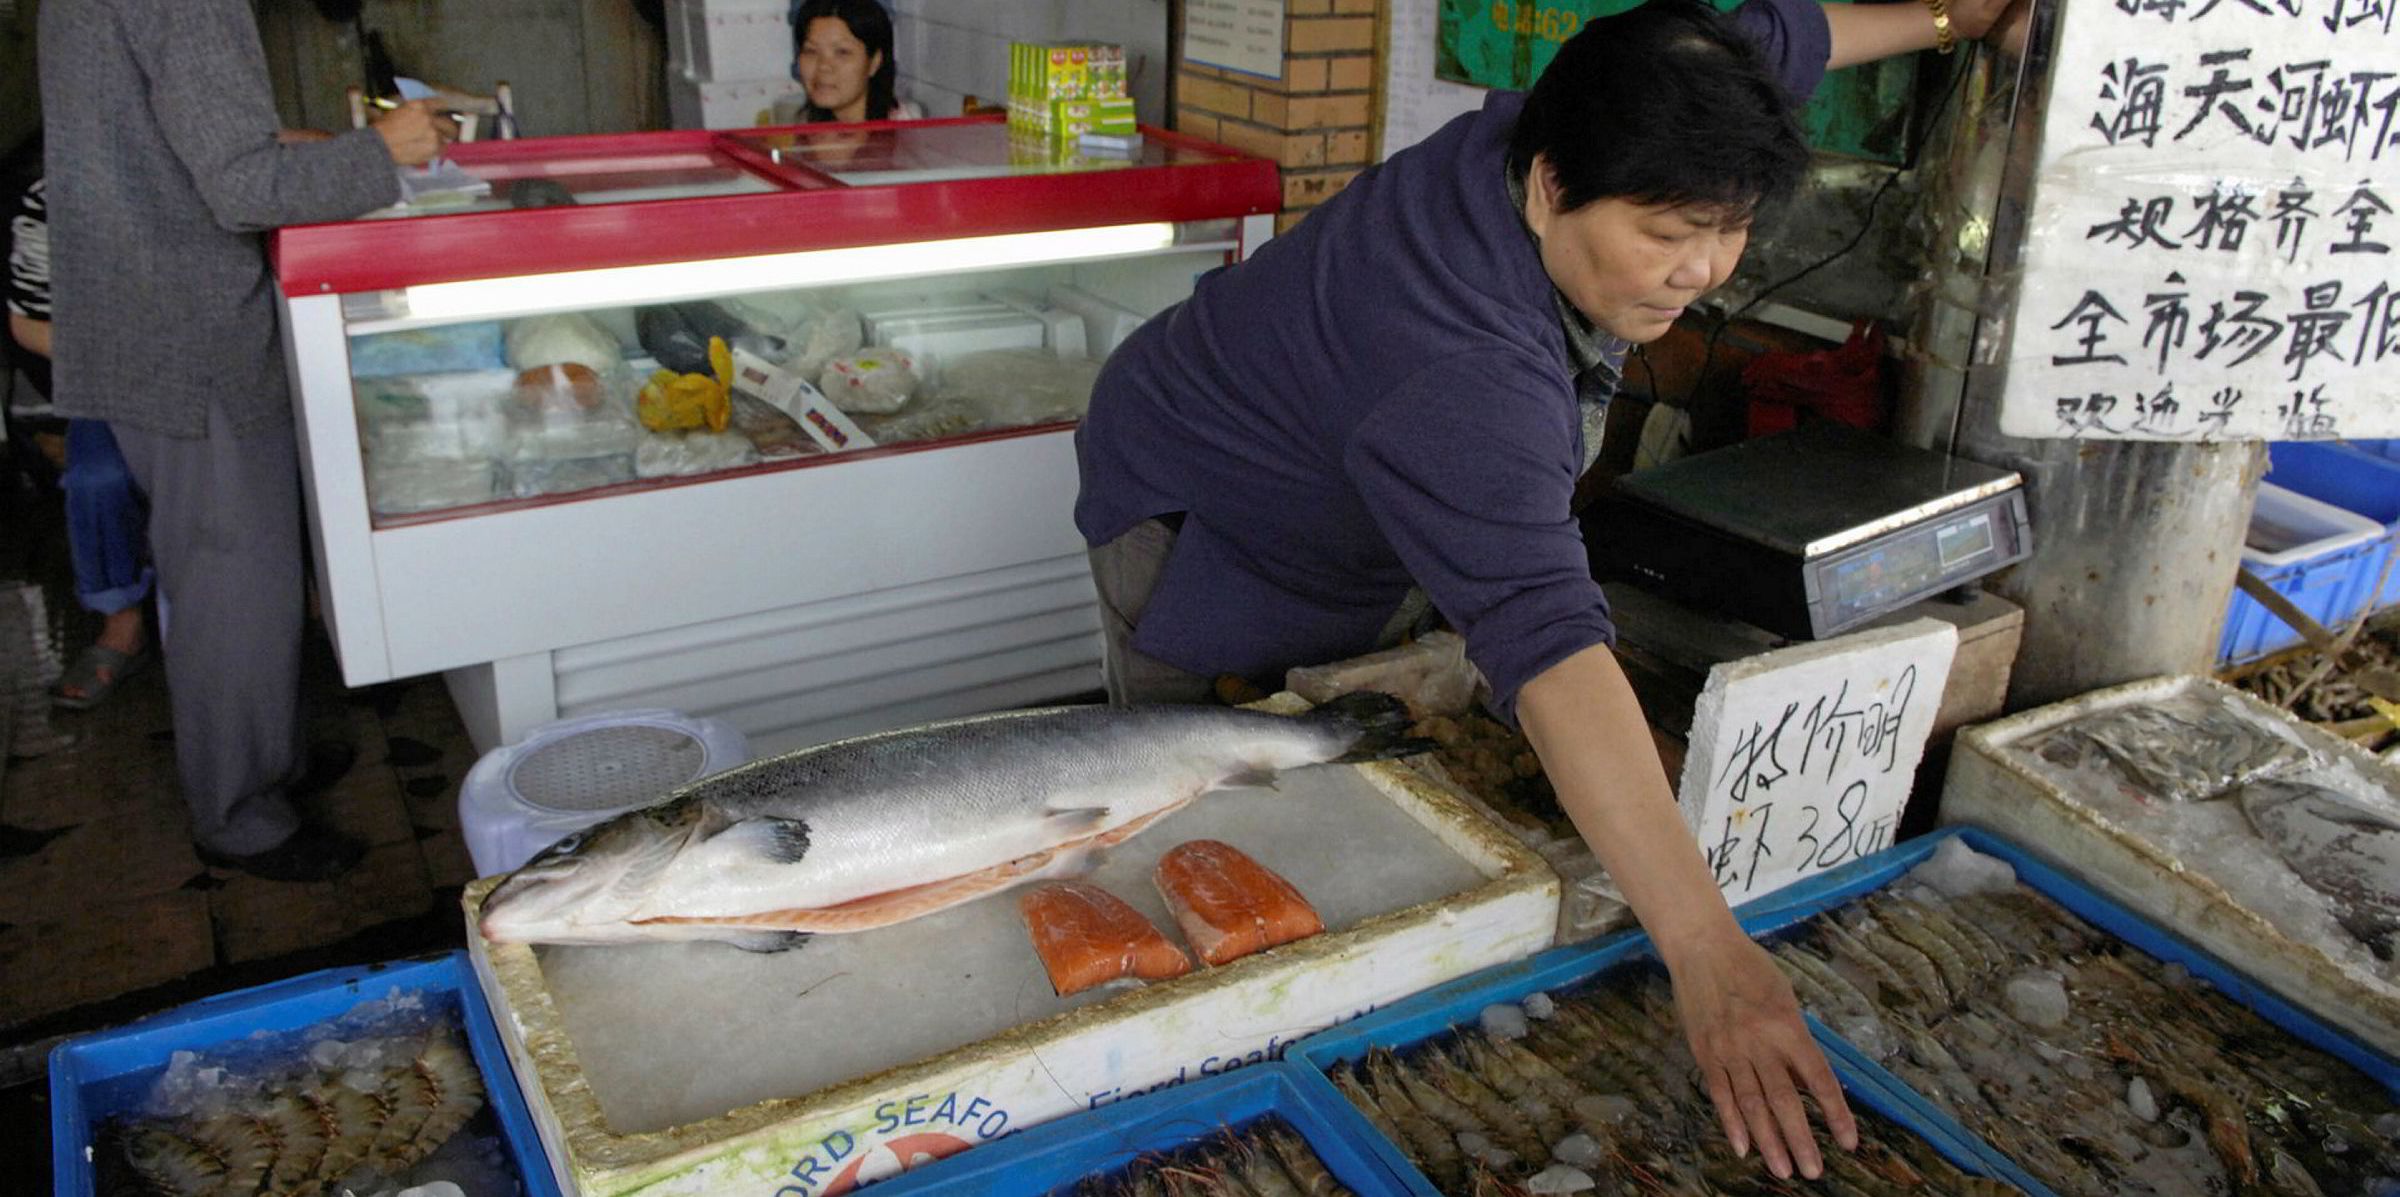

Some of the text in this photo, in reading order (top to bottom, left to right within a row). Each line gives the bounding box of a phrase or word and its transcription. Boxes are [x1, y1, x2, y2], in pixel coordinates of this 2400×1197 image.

[2086, 176, 2394, 264] 规格齐全
[2056, 381, 2342, 438] 欢迎光临
[875, 1091, 1022, 1139] SEAFO
